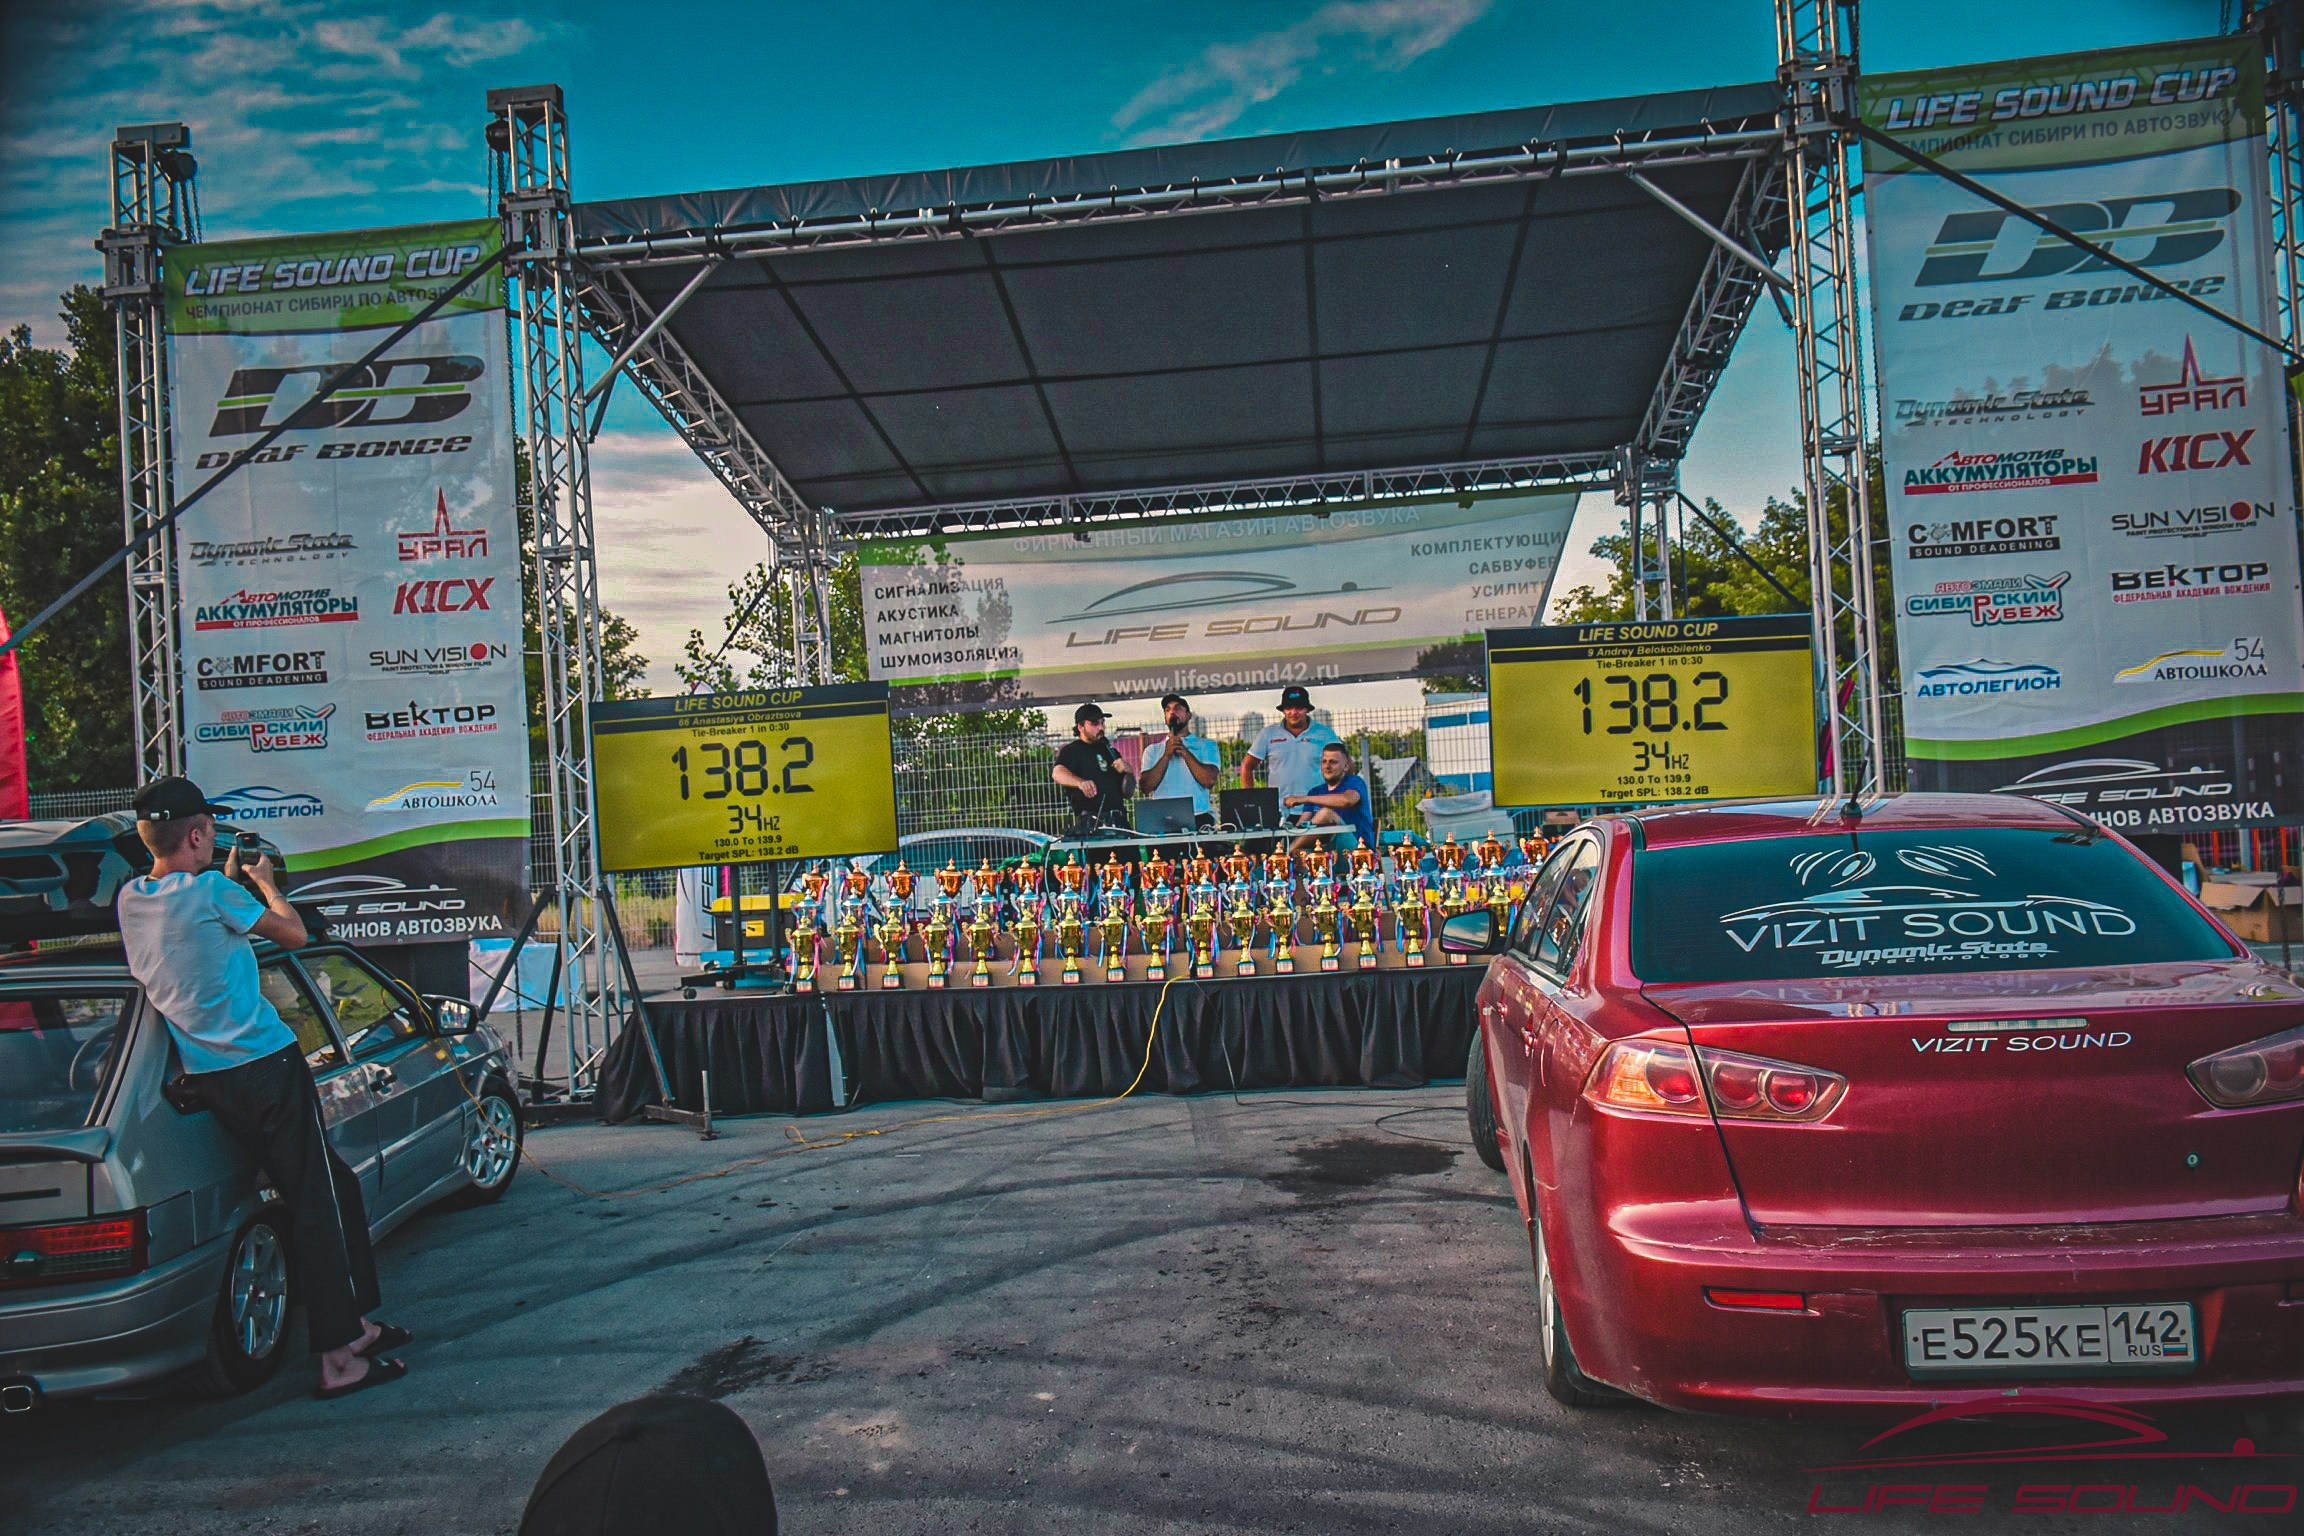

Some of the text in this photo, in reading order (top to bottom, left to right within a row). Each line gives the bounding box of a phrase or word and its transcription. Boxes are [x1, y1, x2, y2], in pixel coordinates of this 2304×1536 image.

[1885, 66, 2237, 130] LIFE SOUND CUP
[2008, 125, 2086, 147] СИБИРИ
[2091, 121, 2118, 137] ПО
[184, 245, 480, 296] LIFE SOUND CUP
[186, 300, 283, 319] ЧЕМПИОНАТ
[288, 295, 354, 312] СИБИРИ
[359, 292, 381, 307] ПО
[1894, 388, 2090, 427] Dynamic State
[2142, 386, 2247, 416] УРАЛ
[1934, 409, 2085, 426] TECHNOLOGY
[2138, 429, 2256, 475] KICX
[1905, 456, 2097, 485] АККУМУЛЯТОРЫ
[1949, 478, 2050, 492] ОТ ПРОФЕССИОНАЛОВ
[1013, 506, 1420, 552] ФИРМЕННЫЙ МАГАЗИН АВТОЗВУКА
[2112, 511, 2169, 530] SUN
[189, 532, 354, 566] Dynamic State
[224, 552, 348, 566] TECHNOLOGY
[398, 538, 488, 561] УРАЛ
[1915, 540, 2054, 557] SOUND DEADENING
[2112, 562, 2269, 591] ВЕКТОР
[393, 577, 495, 615] KICX
[874, 577, 1004, 599] СИГНАЛИЗАЦИЯ
[2113, 583, 2270, 602] ФЕДЕРАЛЬНАЯ АКАДЕМИЯ ВОЖДЕНИЯ
[196, 597, 358, 621] АККУМУЛЯТОРЫ
[877, 604, 959, 623] АКУСТИКА
[246, 616, 320, 627] ПРОФЕССИОНАЛОВ
[1066, 607, 1402, 648] LIFE SOUND
[878, 626, 979, 646] МАГНИТОЛЫ
[1578, 623, 1719, 642] LIFE SOUND CUP
[369, 649, 417, 666] SUN
[880, 647, 1018, 669] ШУМОИЗОЛЯЦИЯ
[1587, 643, 1712, 657] 9 Andrey Belokobilenko
[2234, 637, 2265, 661] 54
[1596, 656, 1703, 669] Tie-Breaker 1 in 0:30
[2155, 663, 2267, 681] АВТОШКОЛА
[203, 674, 322, 688] SOUND DEADENING
[1113, 662, 1339, 696] www.lifesound42.ru
[1917, 676, 2061, 697] АВТОЛЕГИОН
[675, 691, 802, 712] LIFE SOUND CUP
[1573, 671, 1729, 735] 138.2
[365, 703, 495, 730] ВЕКТОР
[678, 711, 801, 727] 66 Anastasiya Obraztsova
[367, 723, 497, 741] ФЕДЕРАЛЬНАЯ АКАДЕМИЯ ВОЖДЕНИЯ
[692, 722, 789, 738] Tie-Breaker 1 in 0:30
[671, 736, 815, 800] 138.2
[470, 771, 496, 791] 54
[1617, 774, 1691, 785] 130.0 To 139.9
[401, 795, 497, 808] АВТОШКОЛА
[1600, 786, 1709, 799] Target SPL: 138.2 dB
[2098, 783, 2232, 802] SOUND
[2148, 802, 2275, 824] АВТОЗВУКА
[714, 834, 782, 847] 130.0 To 139.9
[698, 845, 799, 862] Target SPL: 138.2 dB
[357, 900, 466, 914] SOUND
[396, 915, 502, 936] АВТОЗВУКА
[1725, 911, 2136, 953] VIZIT SOUND
[1816, 941, 2050, 969] Dynamic State
[1868, 953, 2048, 965] TECHNOLOGY
[1912, 1032, 2132, 1053] VIZIT SOUND
[2111, 1310, 2181, 1344] 142
[2128, 1344, 2162, 1356] RUS
